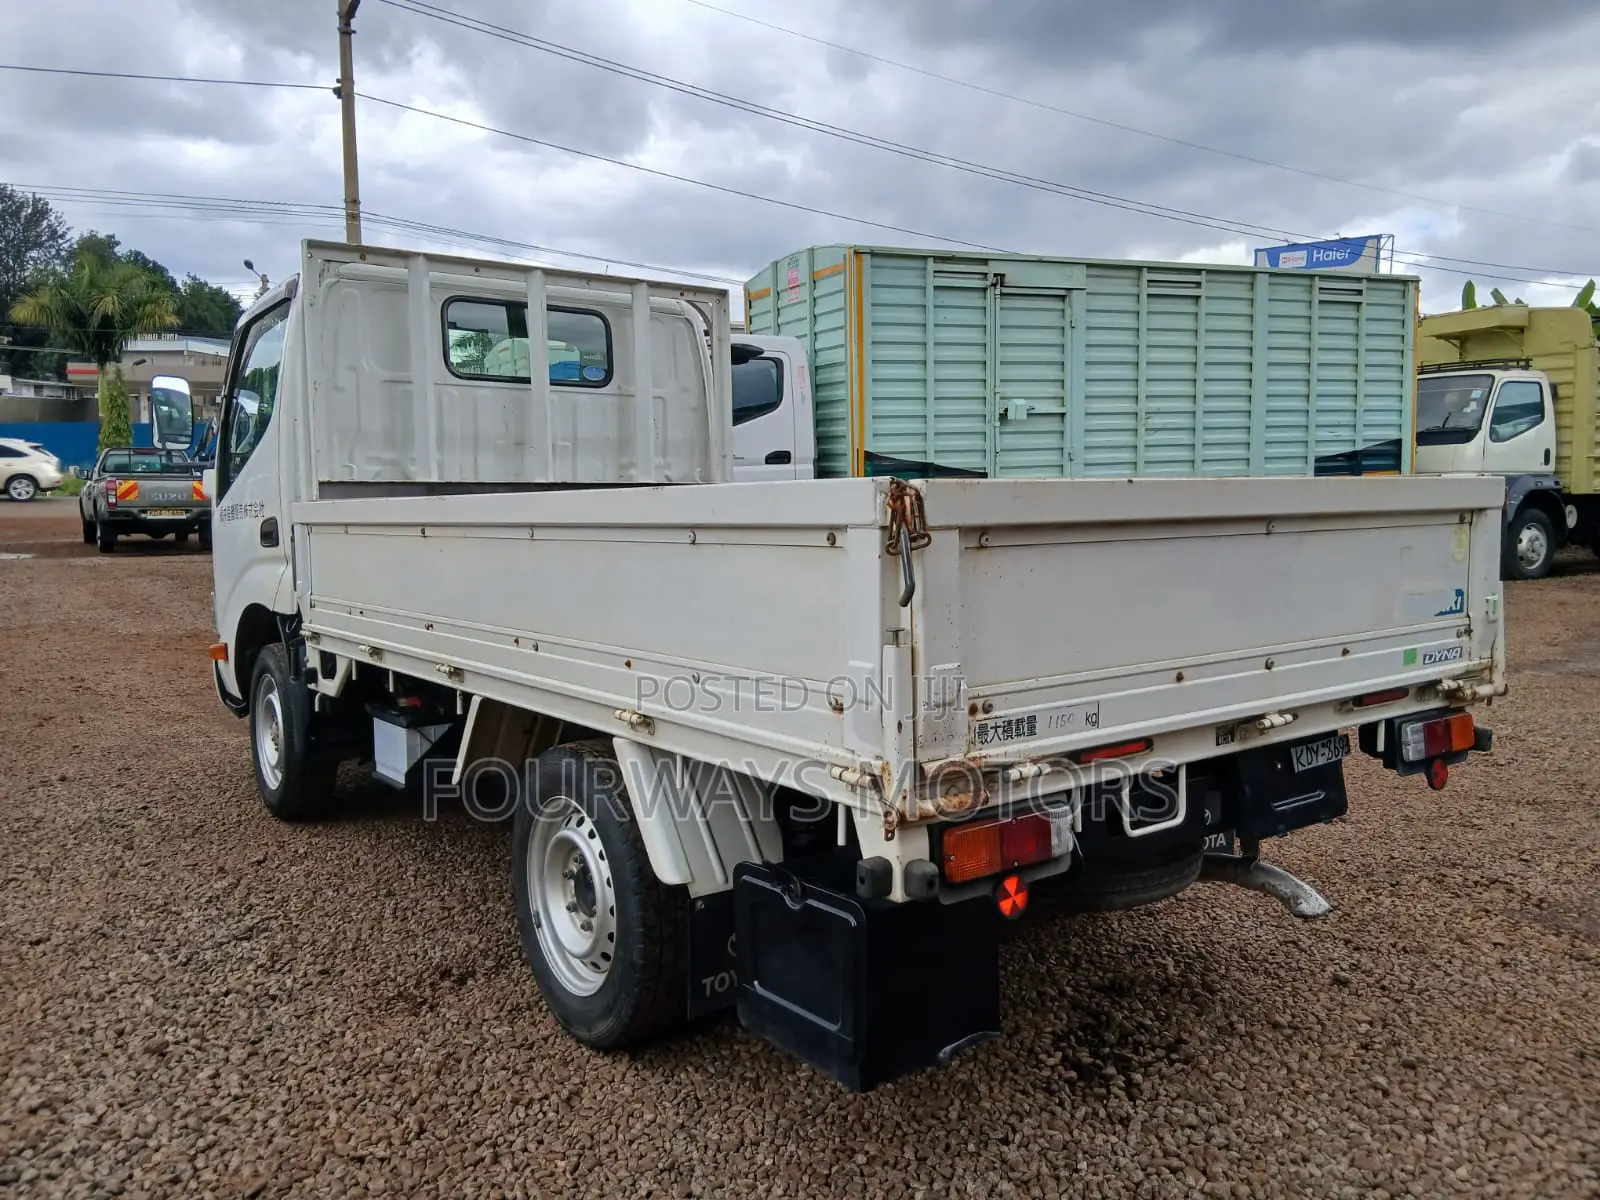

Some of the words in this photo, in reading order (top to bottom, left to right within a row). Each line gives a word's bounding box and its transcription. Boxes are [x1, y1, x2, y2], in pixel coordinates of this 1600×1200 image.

[1312, 247, 1351, 263] Haier
[1423, 647, 1462, 665] DYNA
[976, 714, 1038, 746] 最大積載量
[1085, 711, 1099, 727] kg
